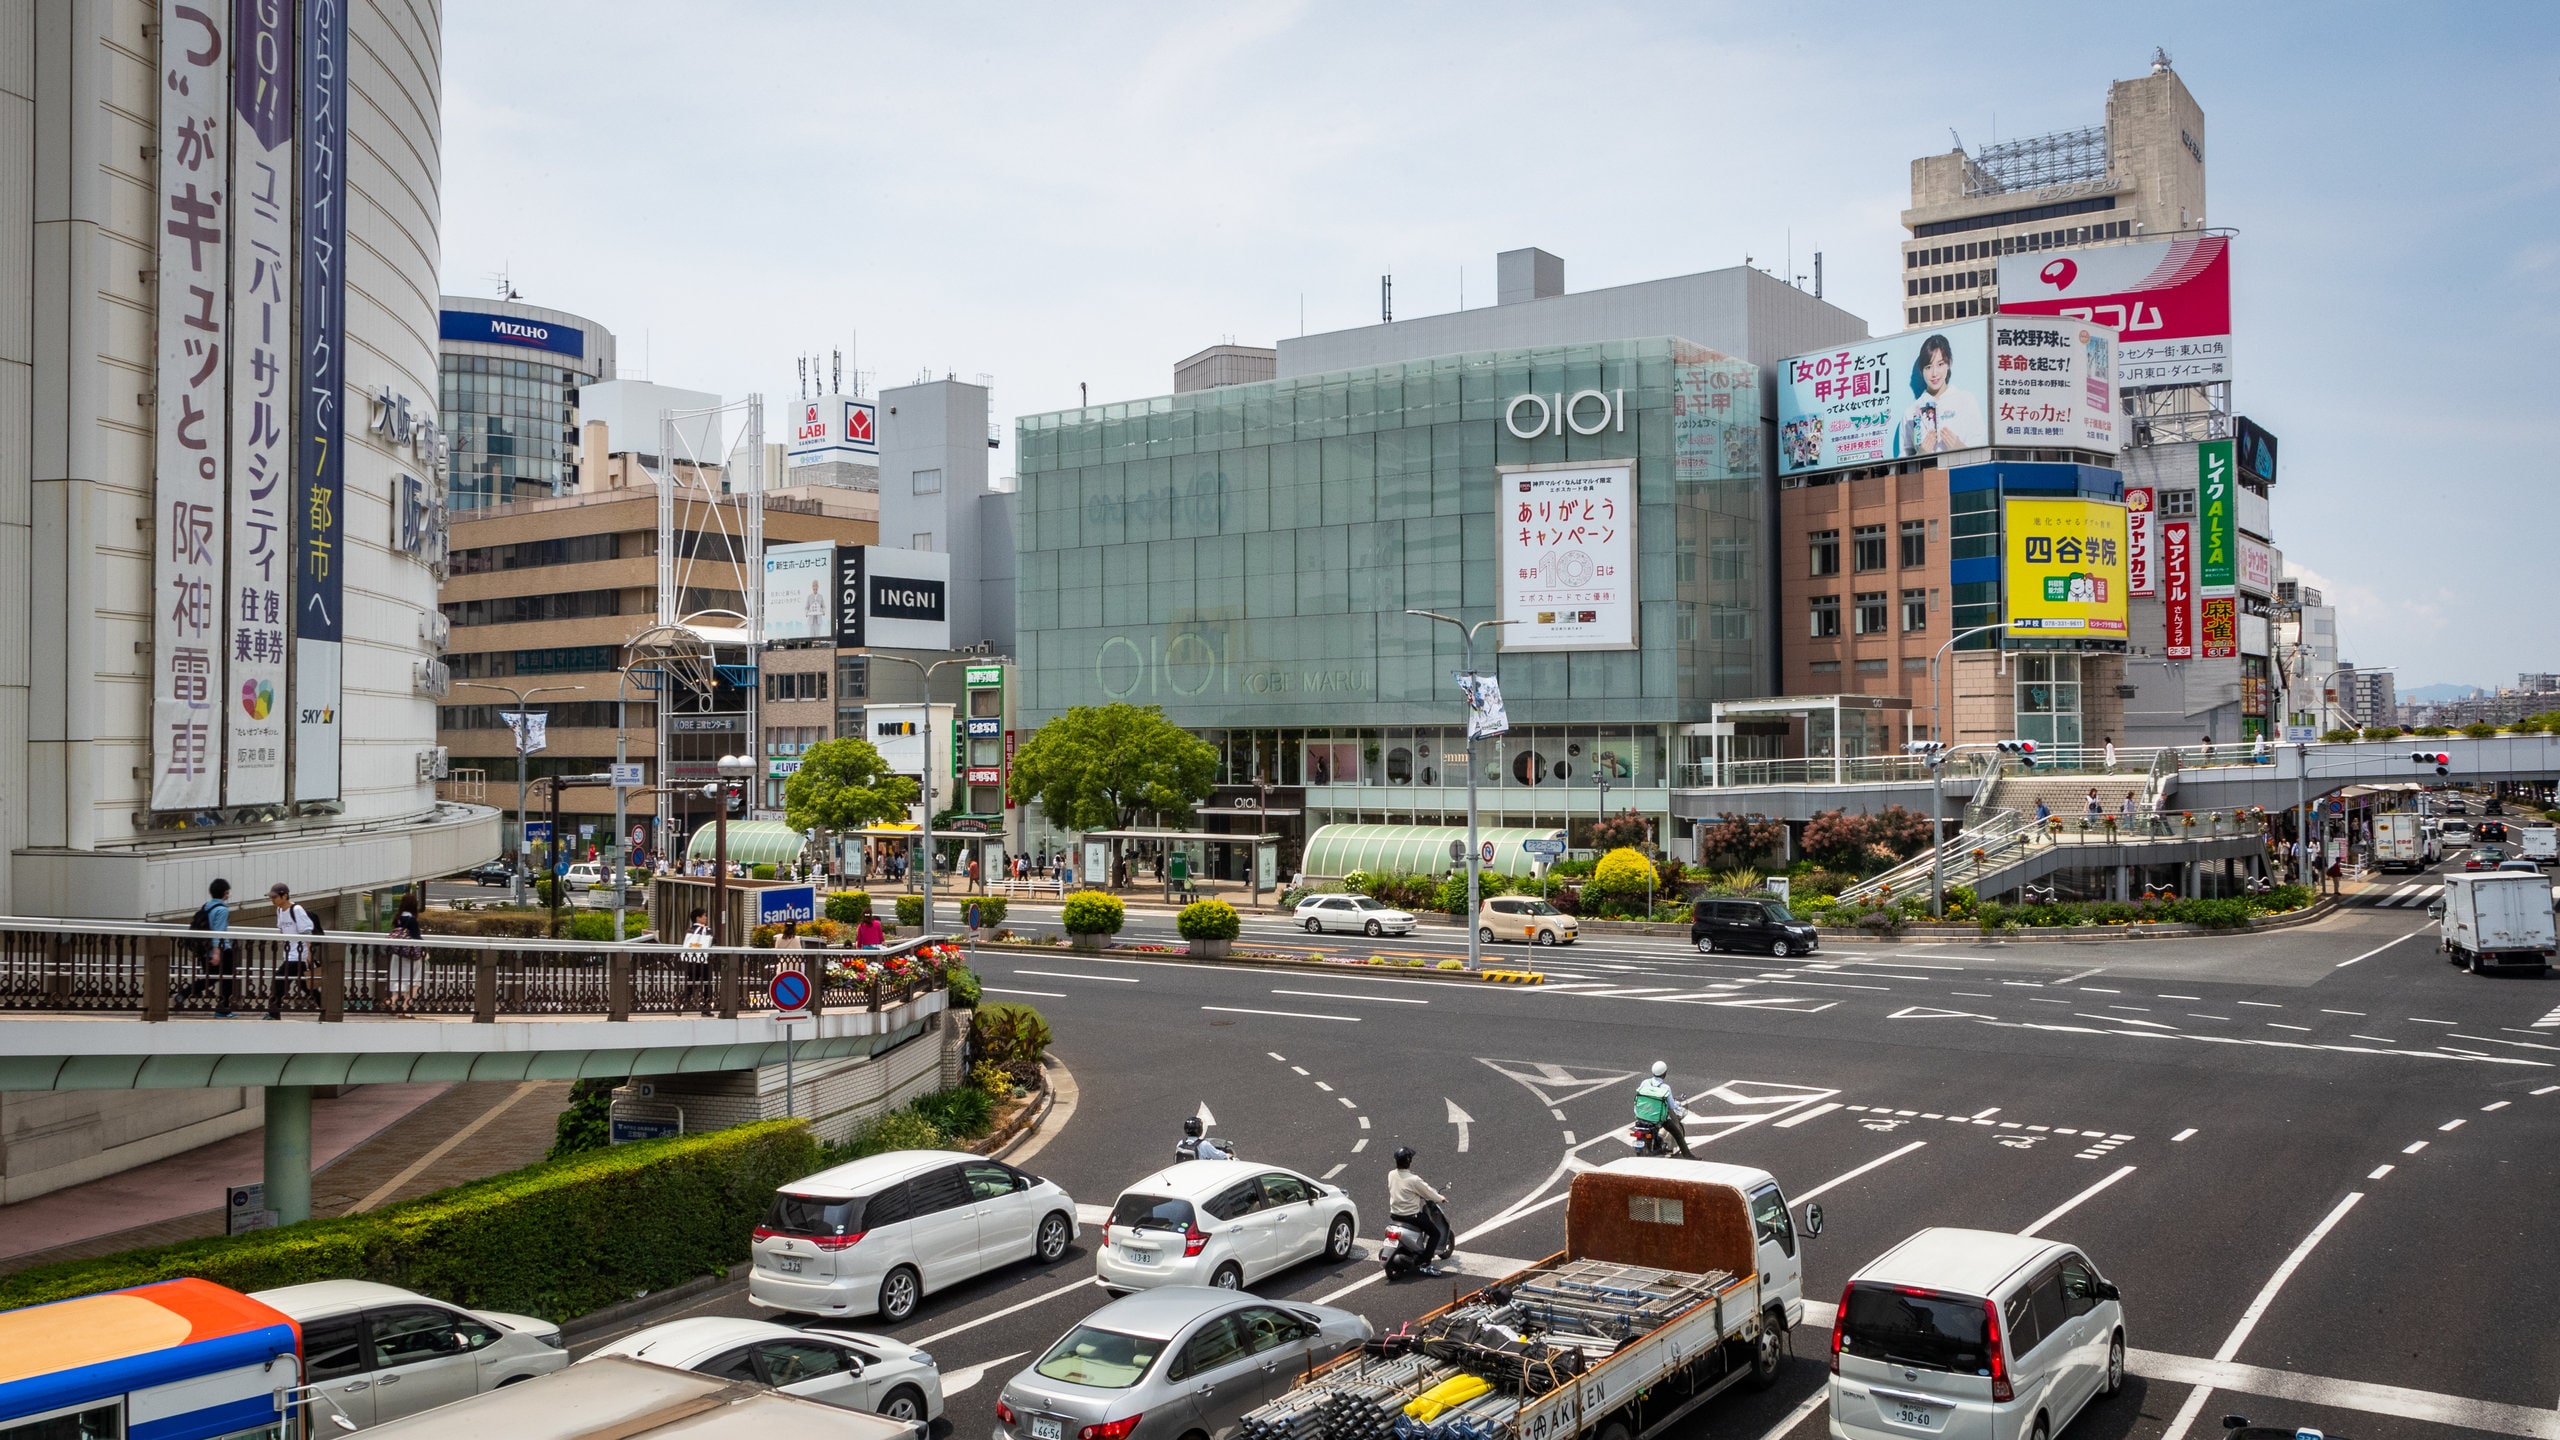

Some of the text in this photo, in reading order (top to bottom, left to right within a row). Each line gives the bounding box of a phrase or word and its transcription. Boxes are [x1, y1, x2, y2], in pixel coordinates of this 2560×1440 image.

[491, 320, 548, 340] MIZUHO
[1997, 328, 2071, 348] 高校野球に
[2127, 341, 2224, 360] センター街・東入口角
[246, 160, 282, 582] ユニバーサルシティ
[1789, 352, 1889, 385] 「女の子だって
[1997, 354, 2071, 372] 革命を起こす!
[2127, 362, 2224, 381] JR東口・ダイエー隣
[1815, 367, 1891, 403] 甲子園!」
[1998, 379, 2071, 388] これからの日本の野球に
[1826, 396, 1891, 415] ってよくないですか?
[2000, 402, 2072, 423] 女子の力だ!
[798, 423, 826, 440] LABI
[2006, 426, 2021, 435] 桑田
[1837, 438, 1884, 453] 大好評発売中!!
[1518, 498, 1614, 523] ありがとう
[1519, 525, 1614, 547] キャンペーン
[2025, 536, 2117, 566] 四谷学院
[2130, 513, 2146, 589] ジャンカラ
[776, 556, 828, 570] 新生ホームサービス
[2169, 544, 2187, 602] アイフル
[241, 586, 280, 625] 往復
[843, 559, 856, 634] INGNI
[880, 588, 936, 608] INGNI
[2203, 599, 2233, 640] 麻雀
[167, 500, 214, 783] 阪神電車
[235, 627, 284, 665] 乗車券
[2208, 647, 2230, 656] 3F
[1241, 671, 1296, 694] KOBE
[1303, 670, 1370, 692] MARUI
[301, 709, 322, 724] SKY
[674, 720, 695, 730] KOBE
[968, 722, 998, 733] 記念写真
[2290, 728, 2312, 737] 三宮
[616, 767, 640, 778] 三宮
[781, 762, 798, 772] LiVE
[968, 771, 998, 782] 証明写真
[635, 830, 643, 840] 50
[642, 1085, 651, 1096] D
[1134, 1253, 1151, 1263] 13-83
[1901, 1410, 1930, 1426] 90-60
[1038, 1426, 1060, 1440] 66-56
